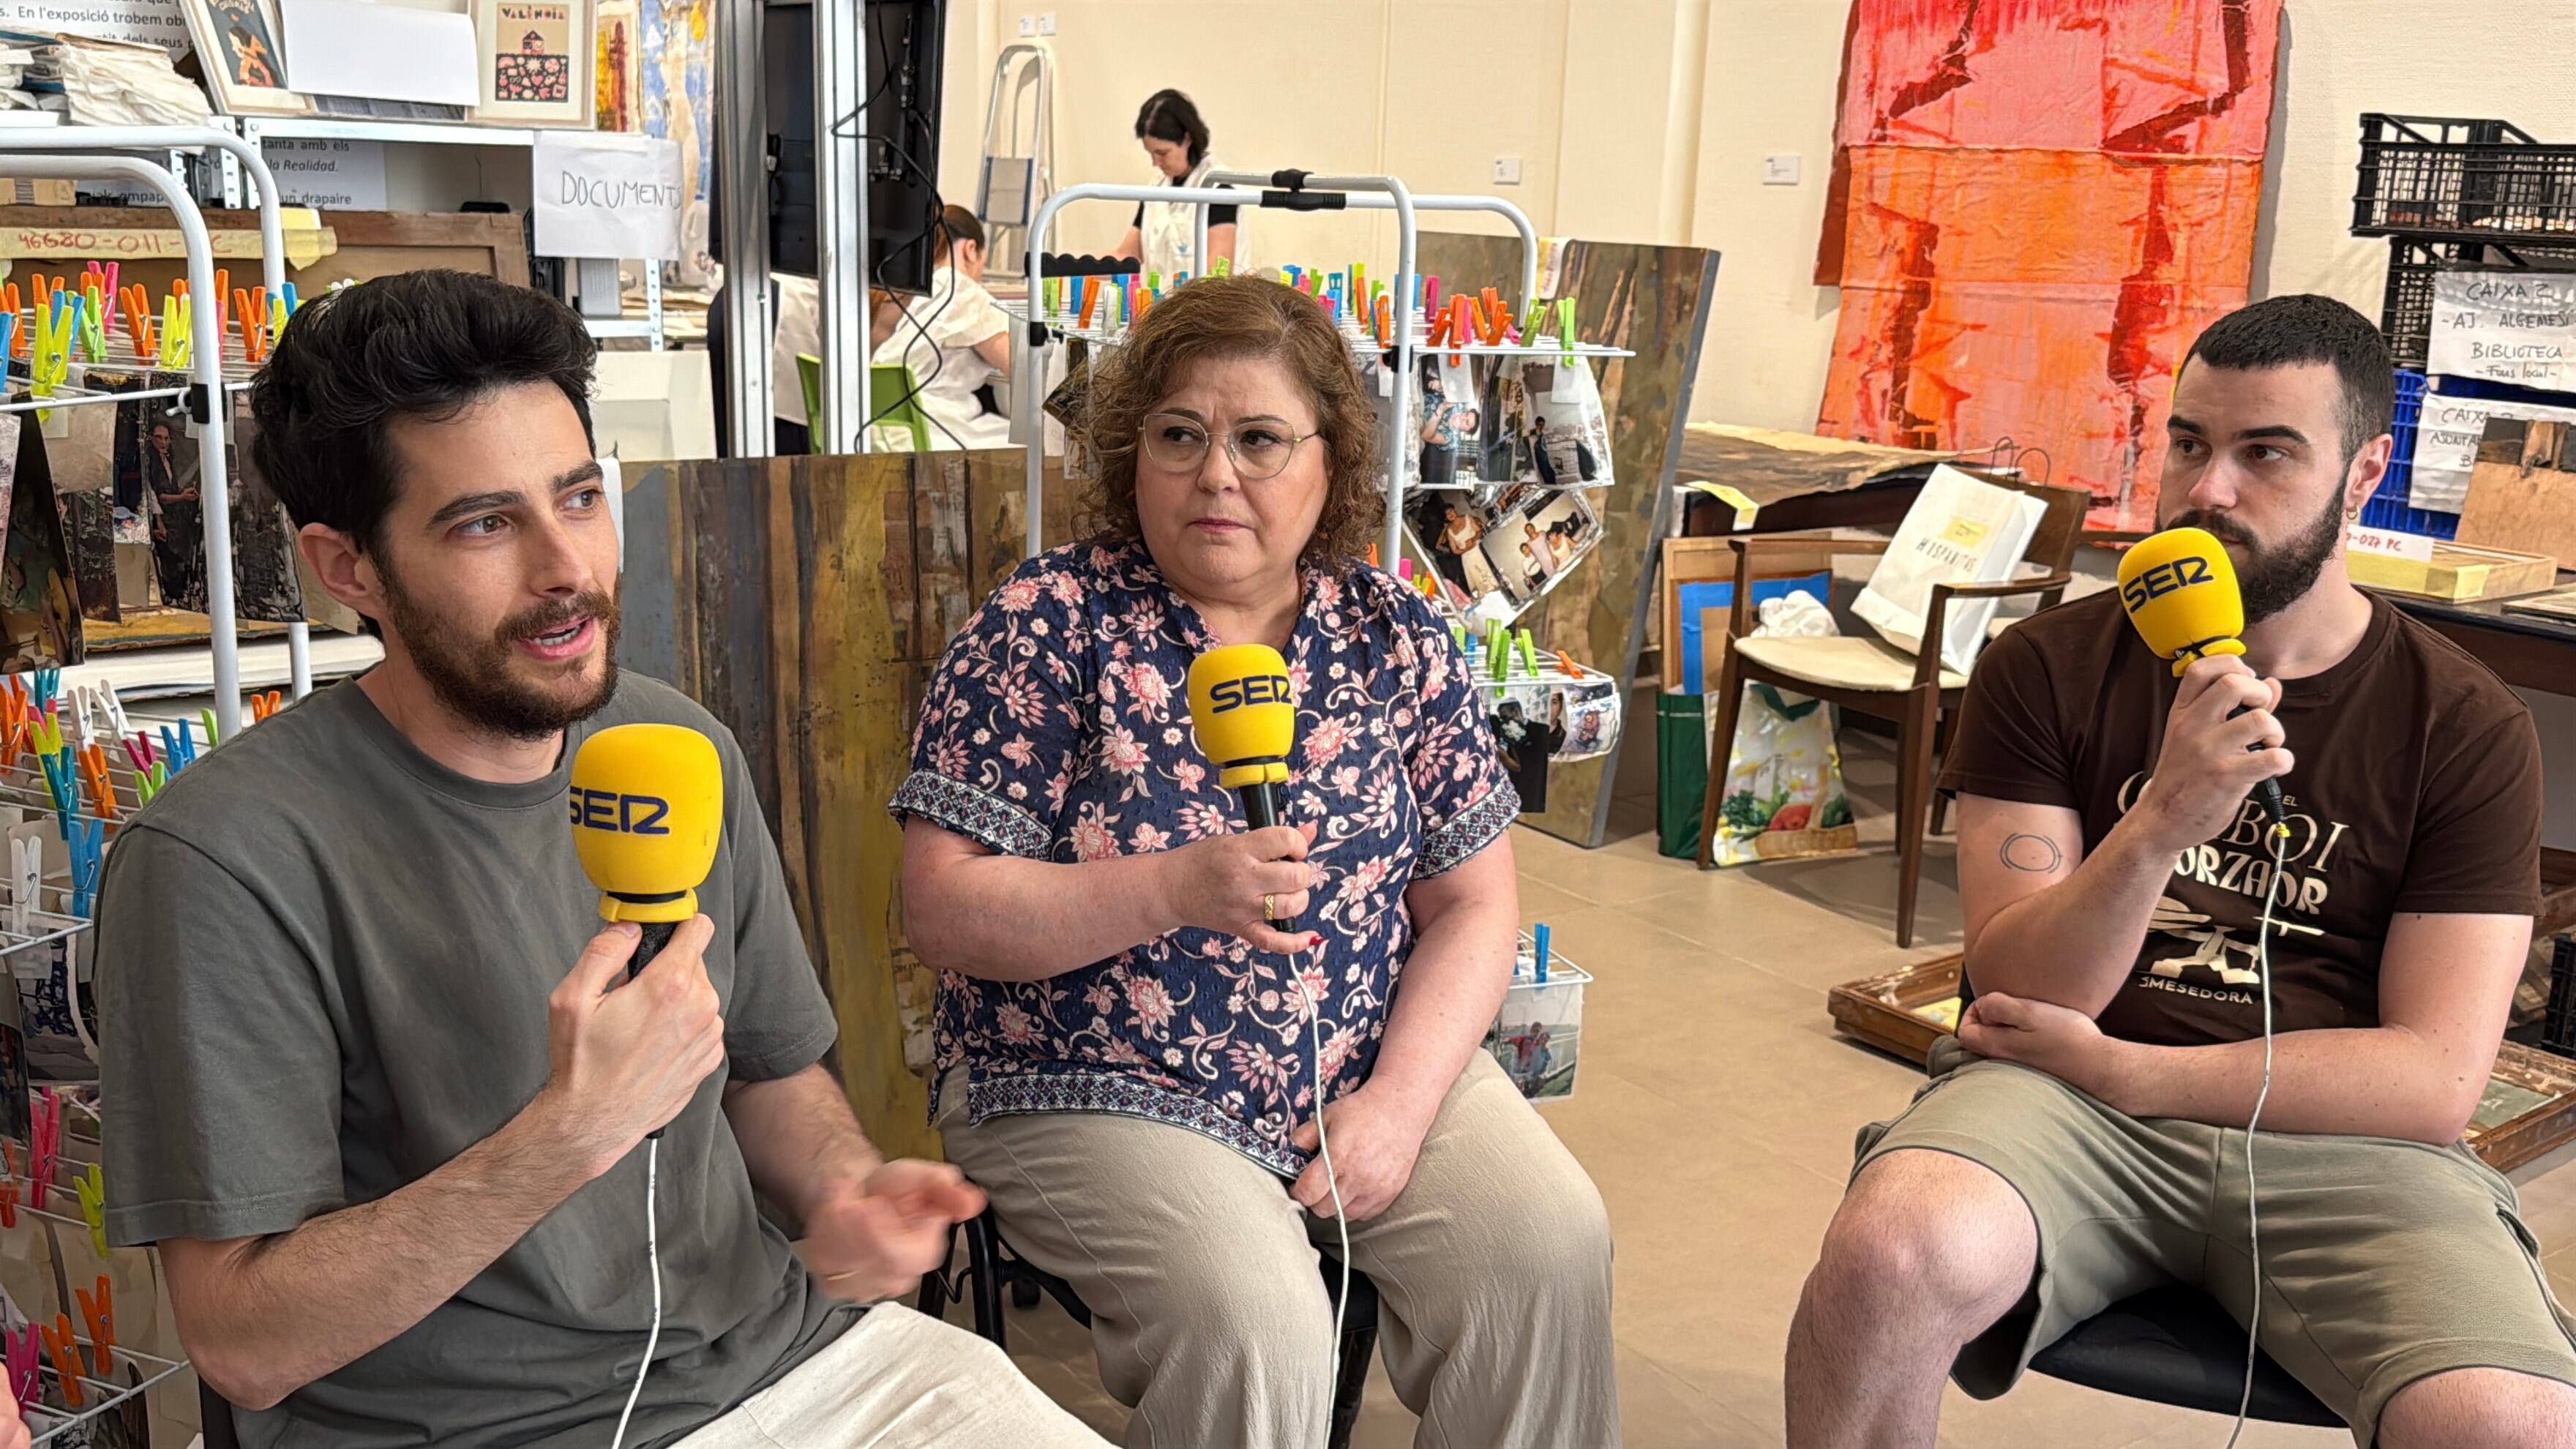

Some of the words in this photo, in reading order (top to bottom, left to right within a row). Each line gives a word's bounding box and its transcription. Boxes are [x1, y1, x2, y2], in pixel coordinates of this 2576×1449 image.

[18, 6, 34, 18] En
[39, 6, 109, 23] l'exposició
[113, 11, 162, 26] trobem
[301, 140, 327, 151] amb
[334, 138, 351, 151] els
[283, 158, 338, 172] Realidad.
[302, 192, 351, 207] drapaire
[2466, 282, 2527, 302] CAIXA
[2471, 341, 2563, 359] BIBLIOTECA
[2386, 538, 2402, 552] PC
[2123, 556, 2214, 613] SER
[1210, 675, 1292, 714] SER
[2282, 795, 2298, 806] EL
